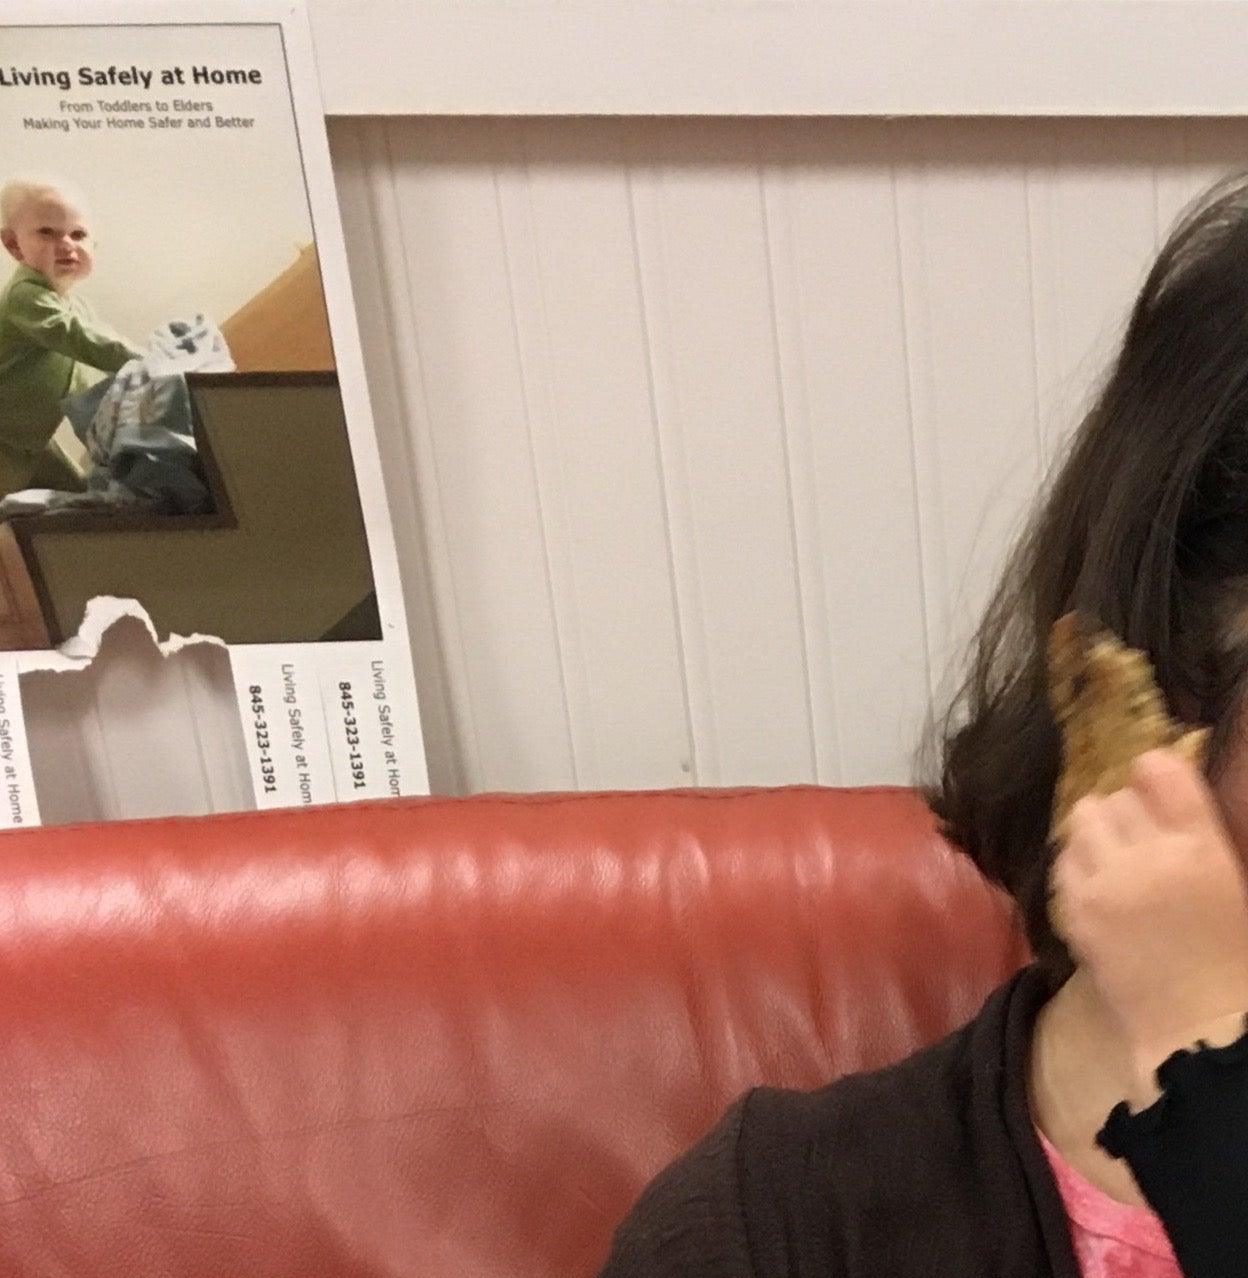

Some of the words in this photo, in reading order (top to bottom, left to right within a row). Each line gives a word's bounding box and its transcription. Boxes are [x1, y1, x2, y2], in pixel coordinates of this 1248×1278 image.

[0, 67, 71, 90] Living
[78, 66, 152, 89] Safely
[161, 66, 185, 85] at
[192, 66, 262, 85] Home
[23, 118, 69, 131] Making
[72, 118, 102, 129] Your
[106, 117, 145, 129] Home
[148, 116, 183, 128] Safer
[187, 116, 211, 128] and
[215, 115, 255, 128] Better
[59, 100, 94, 112] From
[97, 99, 152, 112] Toddlers
[155, 101, 169, 111] to
[173, 99, 213, 111] Elders
[281, 663, 296, 704] Living
[371, 660, 386, 700] Living
[0, 719, 14, 760] Safely
[249, 685, 277, 793] 845-323-1391
[288, 708, 306, 750] Safely
[339, 681, 366, 789] 845-323-1391
[378, 704, 395, 746] Safely
[5, 765, 17, 779] at
[295, 754, 308, 769] at
[384, 751, 397, 765] at
[299, 773, 312, 803] Hom
[388, 768, 400, 796] Hom
[8, 783, 23, 823] Home
